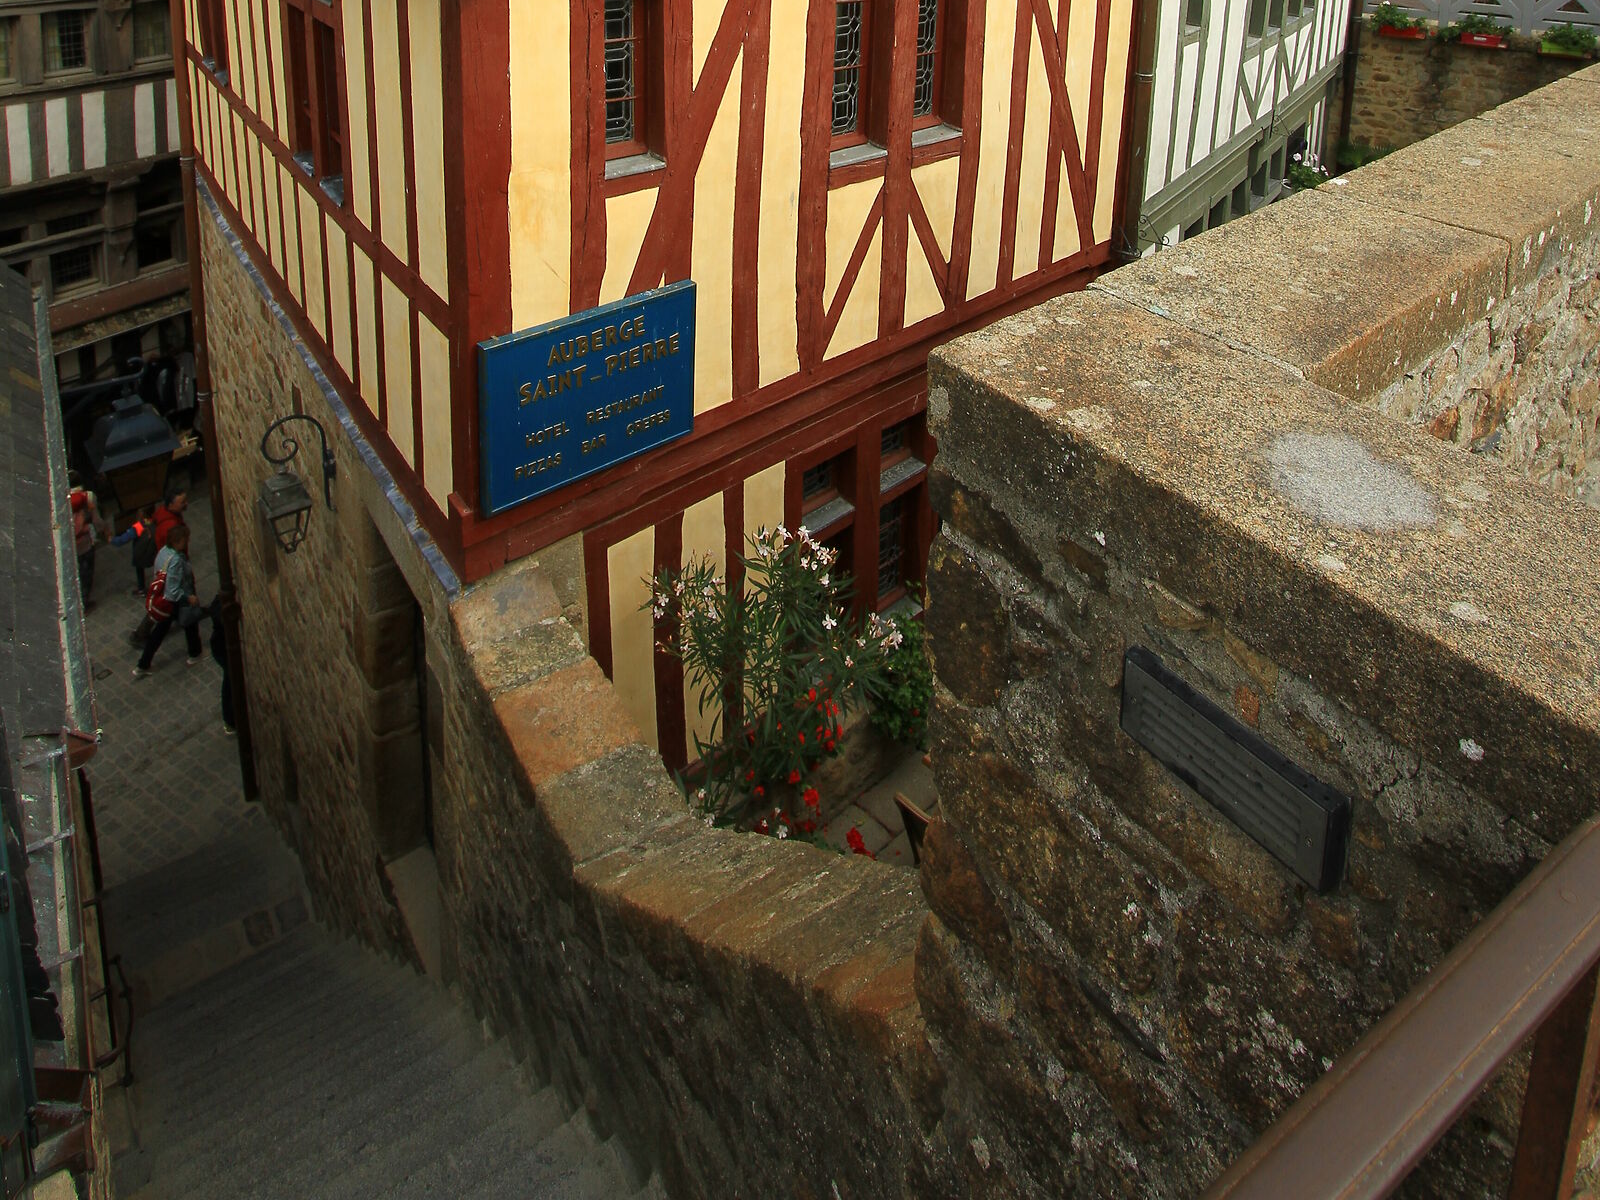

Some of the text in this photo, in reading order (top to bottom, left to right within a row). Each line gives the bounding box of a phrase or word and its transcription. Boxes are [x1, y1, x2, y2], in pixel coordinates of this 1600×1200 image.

[519, 364, 587, 406] SAINT
[605, 332, 680, 376] PIERRE
[547, 315, 646, 368] AUBERGE
[515, 409, 671, 481] PIZZAS BAR CREPES
[525, 385, 665, 448] HOTEL RESTAURANT
